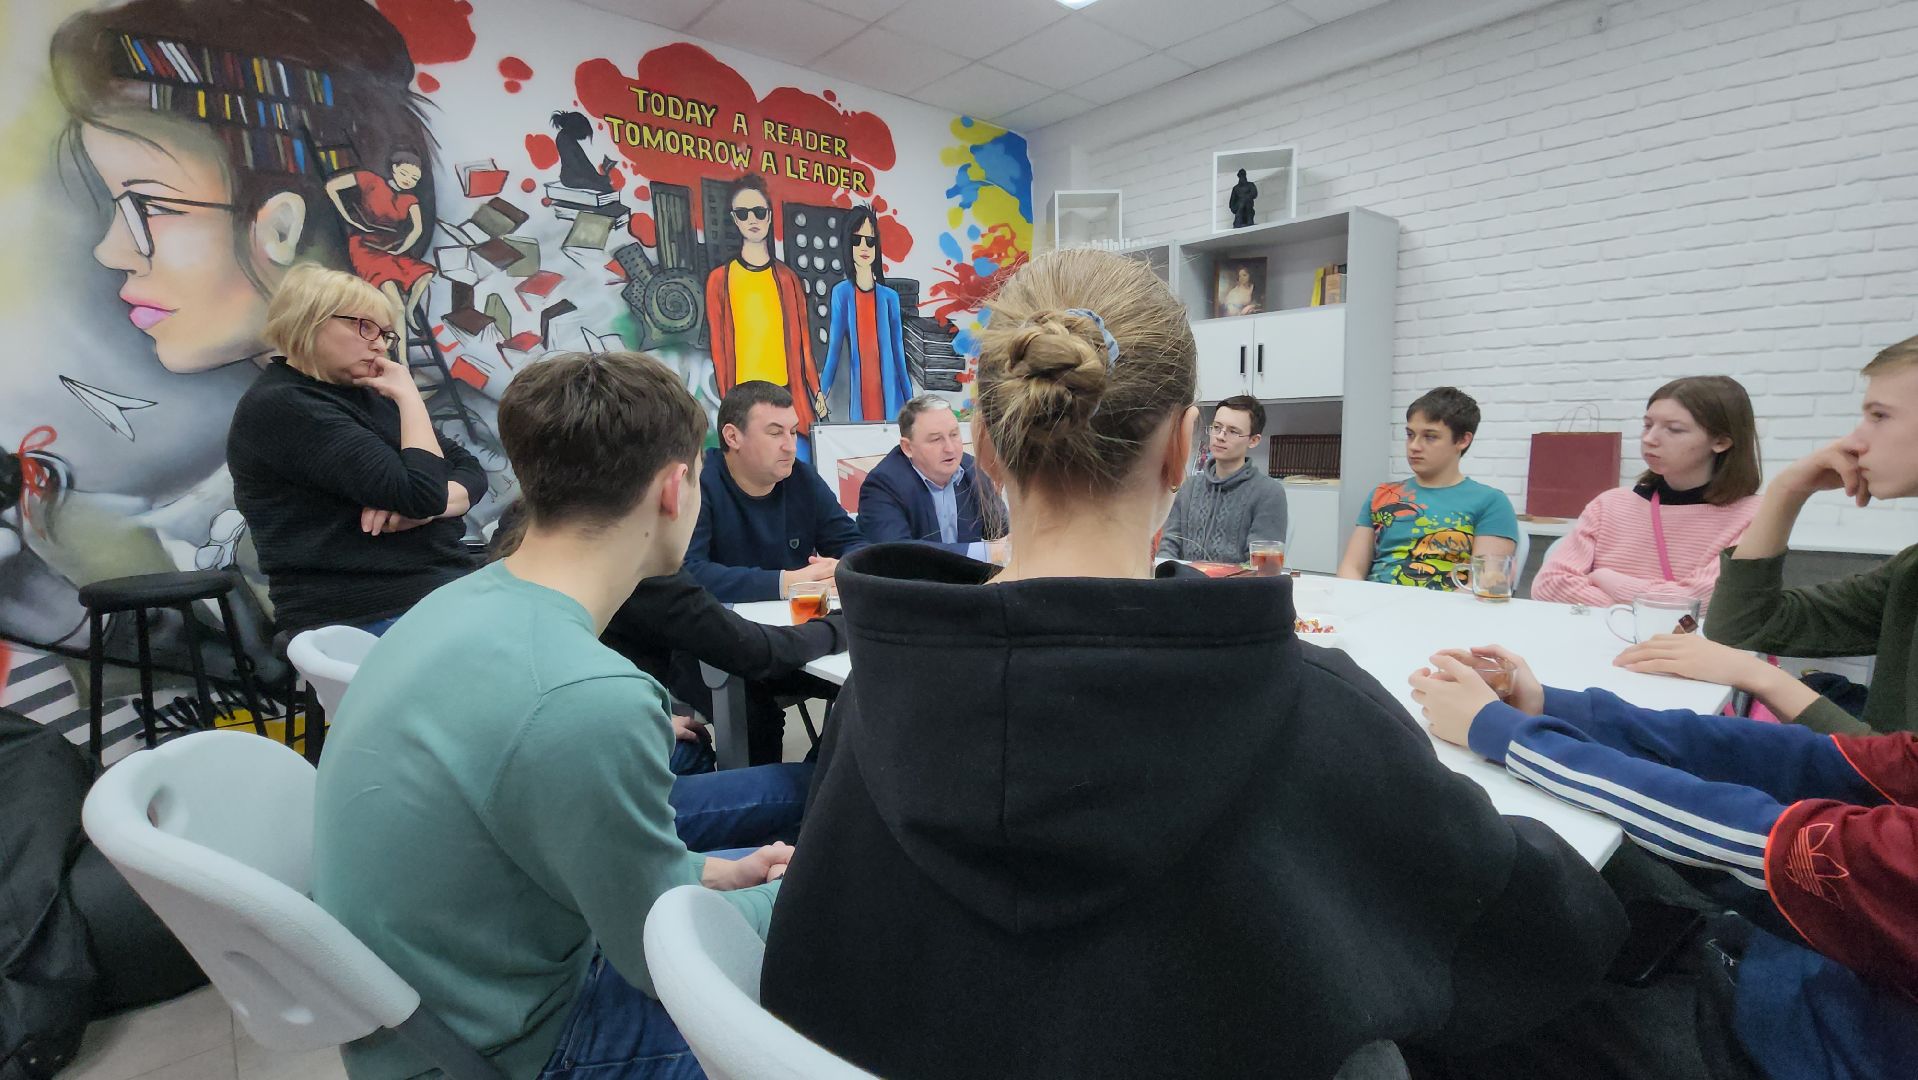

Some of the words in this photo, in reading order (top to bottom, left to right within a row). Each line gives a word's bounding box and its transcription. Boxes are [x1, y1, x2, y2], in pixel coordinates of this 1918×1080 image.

[604, 115, 752, 168] TOMORROW
[760, 151, 779, 175] A
[785, 156, 869, 193] LEADER
[629, 85, 717, 128] TODAY
[732, 112, 749, 136] A
[762, 120, 849, 158] READER
